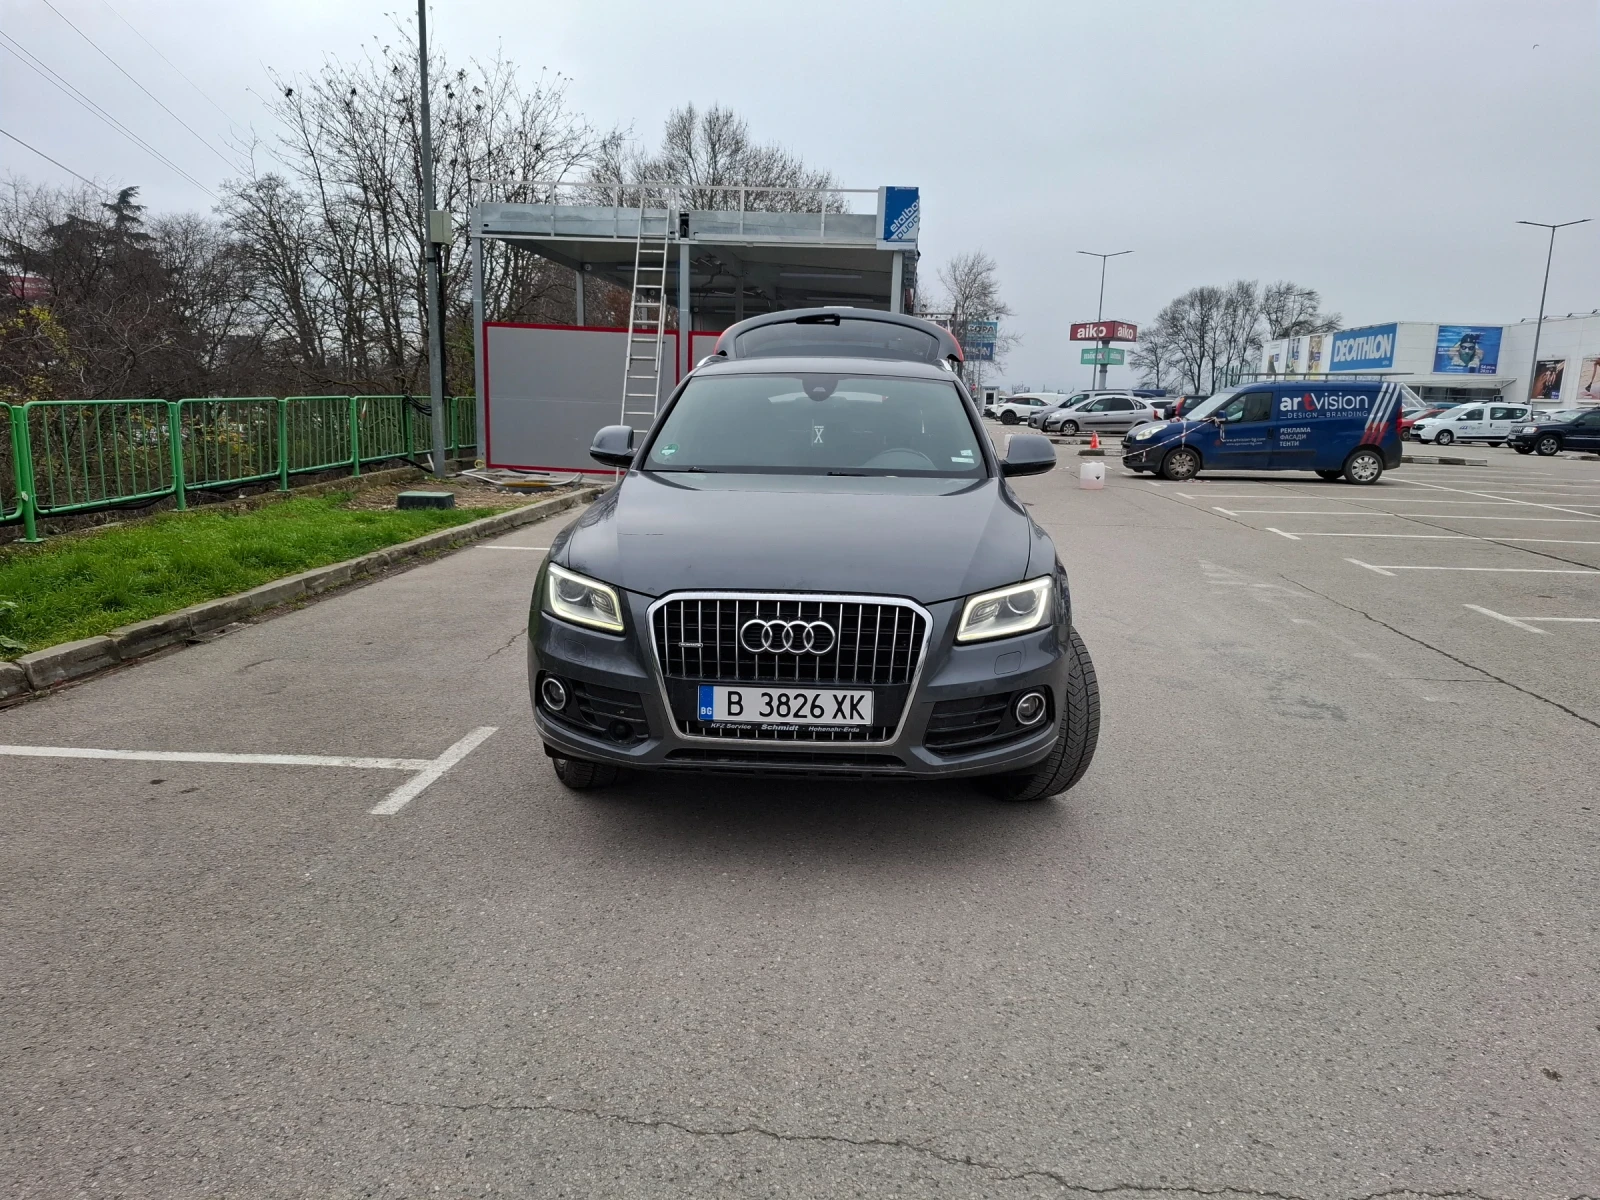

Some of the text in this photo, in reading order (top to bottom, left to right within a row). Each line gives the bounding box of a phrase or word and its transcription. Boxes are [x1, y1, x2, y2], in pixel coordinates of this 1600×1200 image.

[1077, 324, 1106, 338] aiko
[1117, 324, 1134, 339] aiko
[1333, 333, 1393, 362] DECATHLON
[1326, 410, 1368, 418] BRANDING
[700, 707, 713, 715] BG
[727, 690, 866, 720] B 3826 XK
